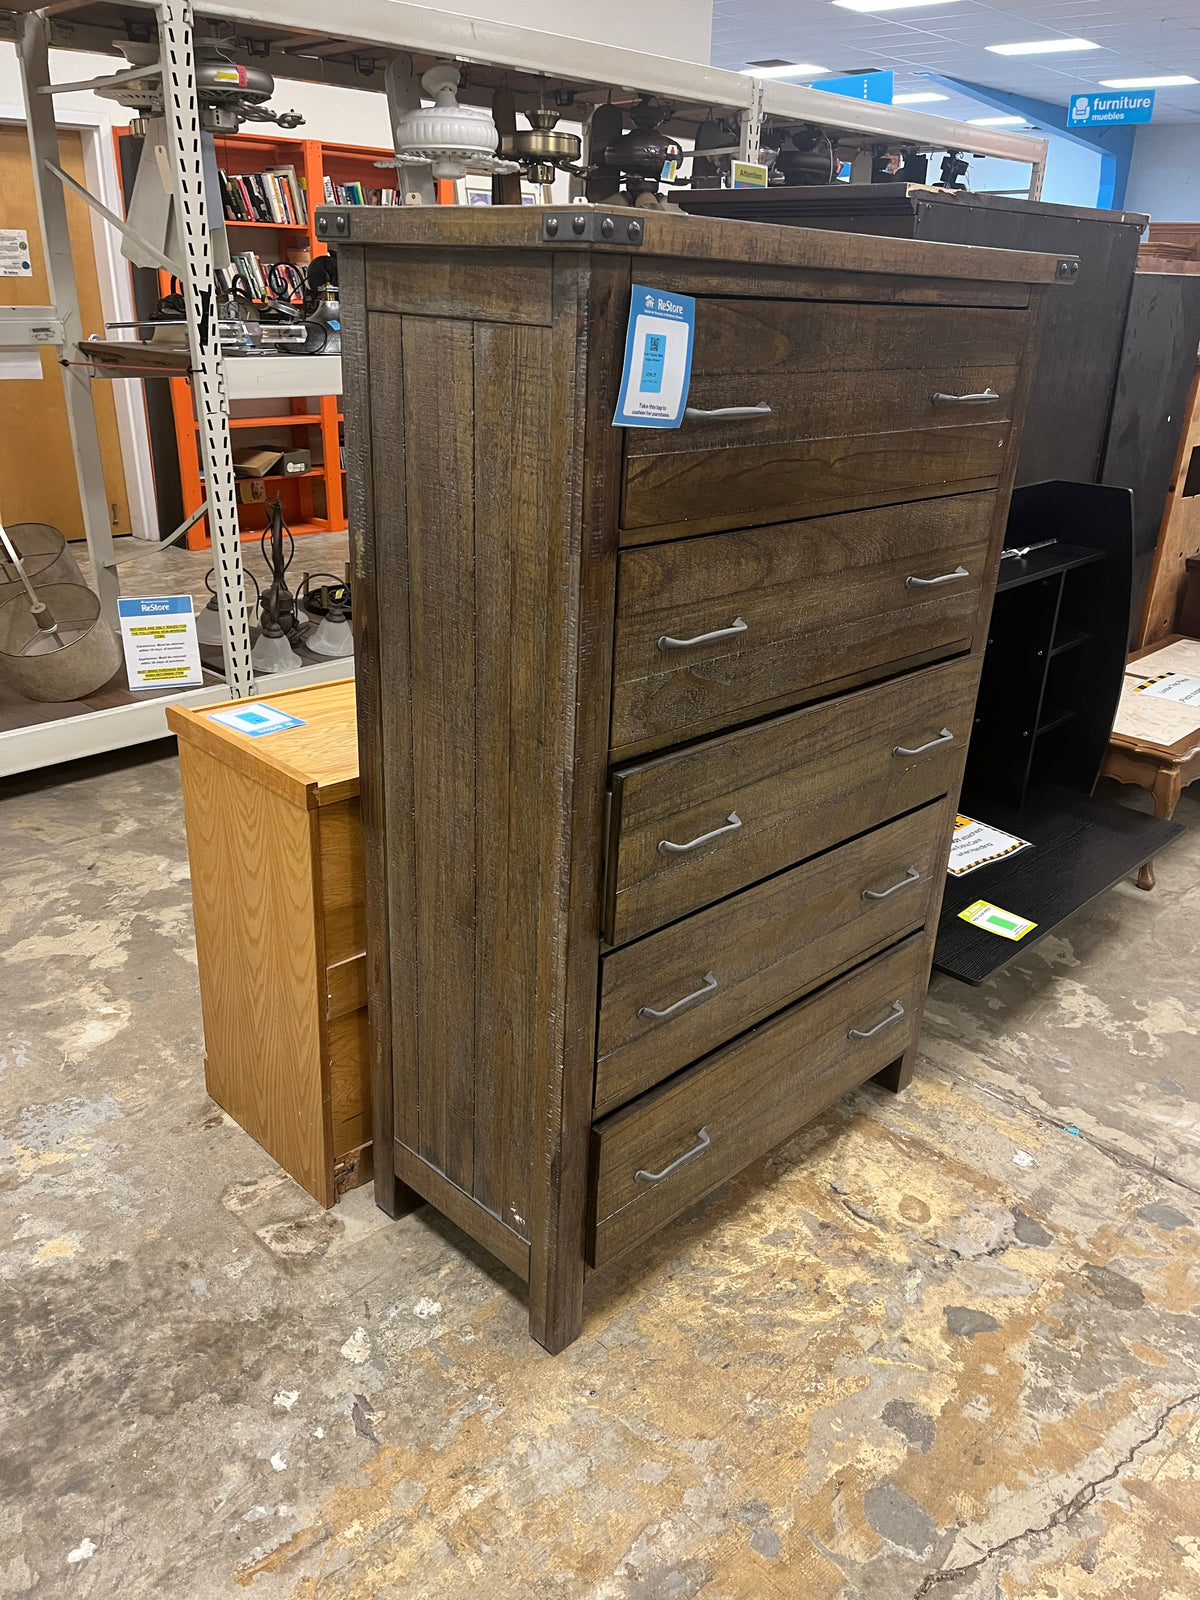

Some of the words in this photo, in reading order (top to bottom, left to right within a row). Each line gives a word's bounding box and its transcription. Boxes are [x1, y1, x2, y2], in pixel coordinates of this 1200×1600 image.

[1093, 96, 1151, 111] furniture
[1091, 112, 1125, 121] muebles
[740, 169, 762, 180] Attention
[657, 298, 684, 314] ReStore
[141, 604, 170, 612] ReStore
